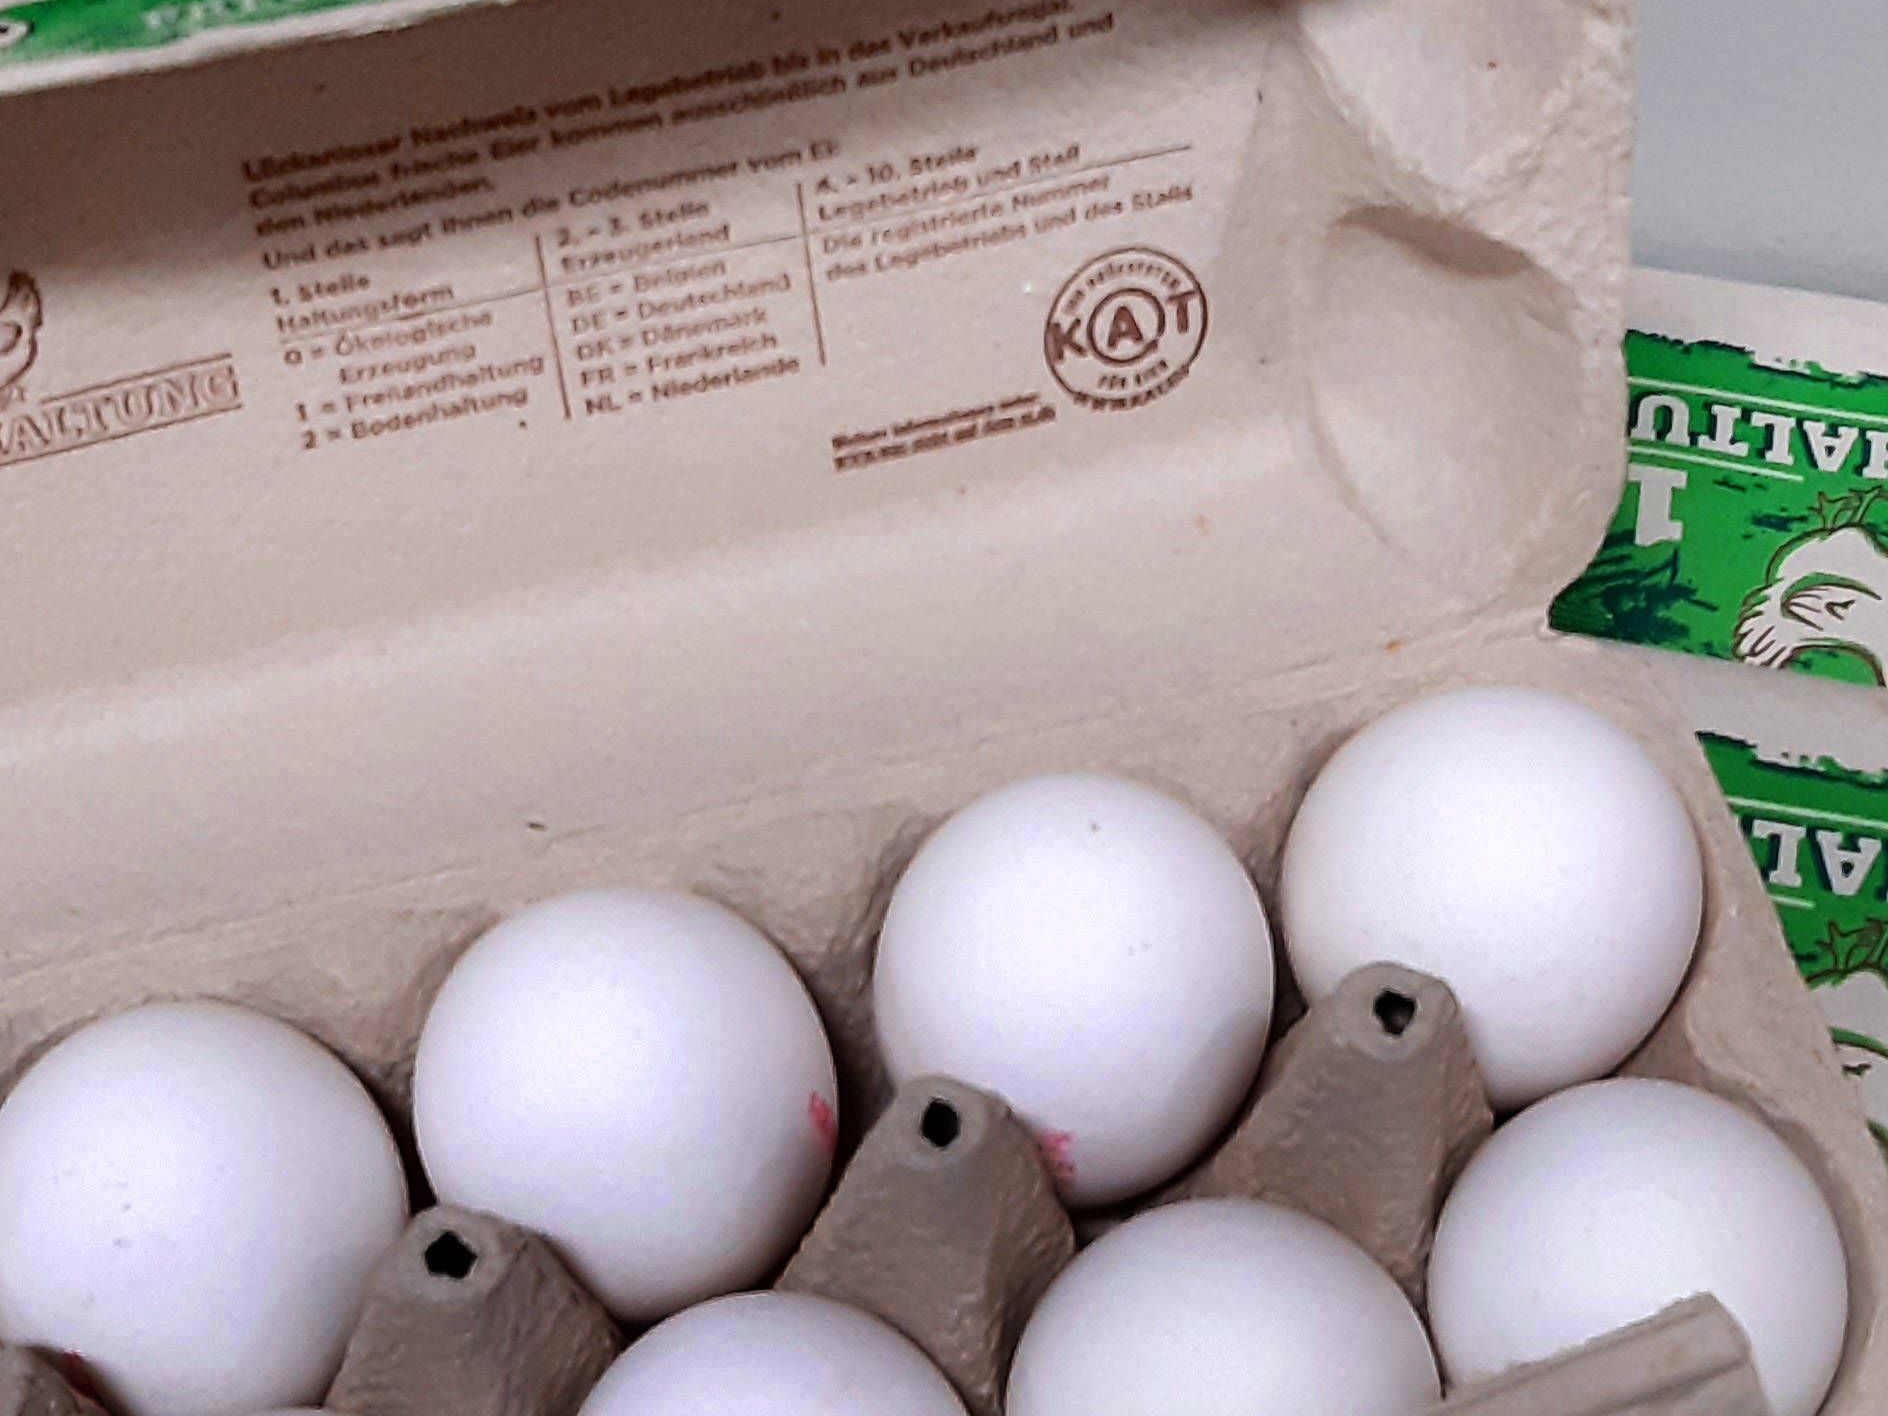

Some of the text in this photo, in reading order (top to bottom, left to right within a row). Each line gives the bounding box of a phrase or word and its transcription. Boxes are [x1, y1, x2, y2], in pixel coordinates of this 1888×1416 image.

[544, 93, 602, 120] vom
[770, 49, 810, 76] bis
[816, 45, 841, 67] in
[846, 37, 891, 64] das
[548, 113, 663, 148] kommen
[855, 65, 898, 89] aus
[905, 25, 1059, 79] Deutschland
[1067, 10, 1116, 41] und
[909, 145, 978, 176] Stelle
[263, 243, 317, 270] Und
[440, 207, 515, 234] Ihnen
[521, 196, 560, 217] die
[745, 148, 803, 174] vom
[817, 174, 970, 221] Legebetrieb
[976, 159, 1022, 186] und
[1012, 175, 1111, 214] Nummer
[1033, 205, 1078, 235] und
[1082, 200, 1124, 223] des
[1130, 183, 1194, 214] Stalls
[274, 287, 456, 332] Haltungsform
[297, 271, 371, 304] Stelle
[637, 272, 792, 321] Deutschland
[335, 312, 494, 357] Ökologische
[647, 331, 778, 374] Frankreich
[1045, 290, 1196, 364] KAT
[338, 344, 478, 385] Erzeugung
[343, 356, 545, 413] Freilandhaltung
[584, 356, 801, 416] NL Niederlande
[350, 387, 528, 440] Bodenhaltung
